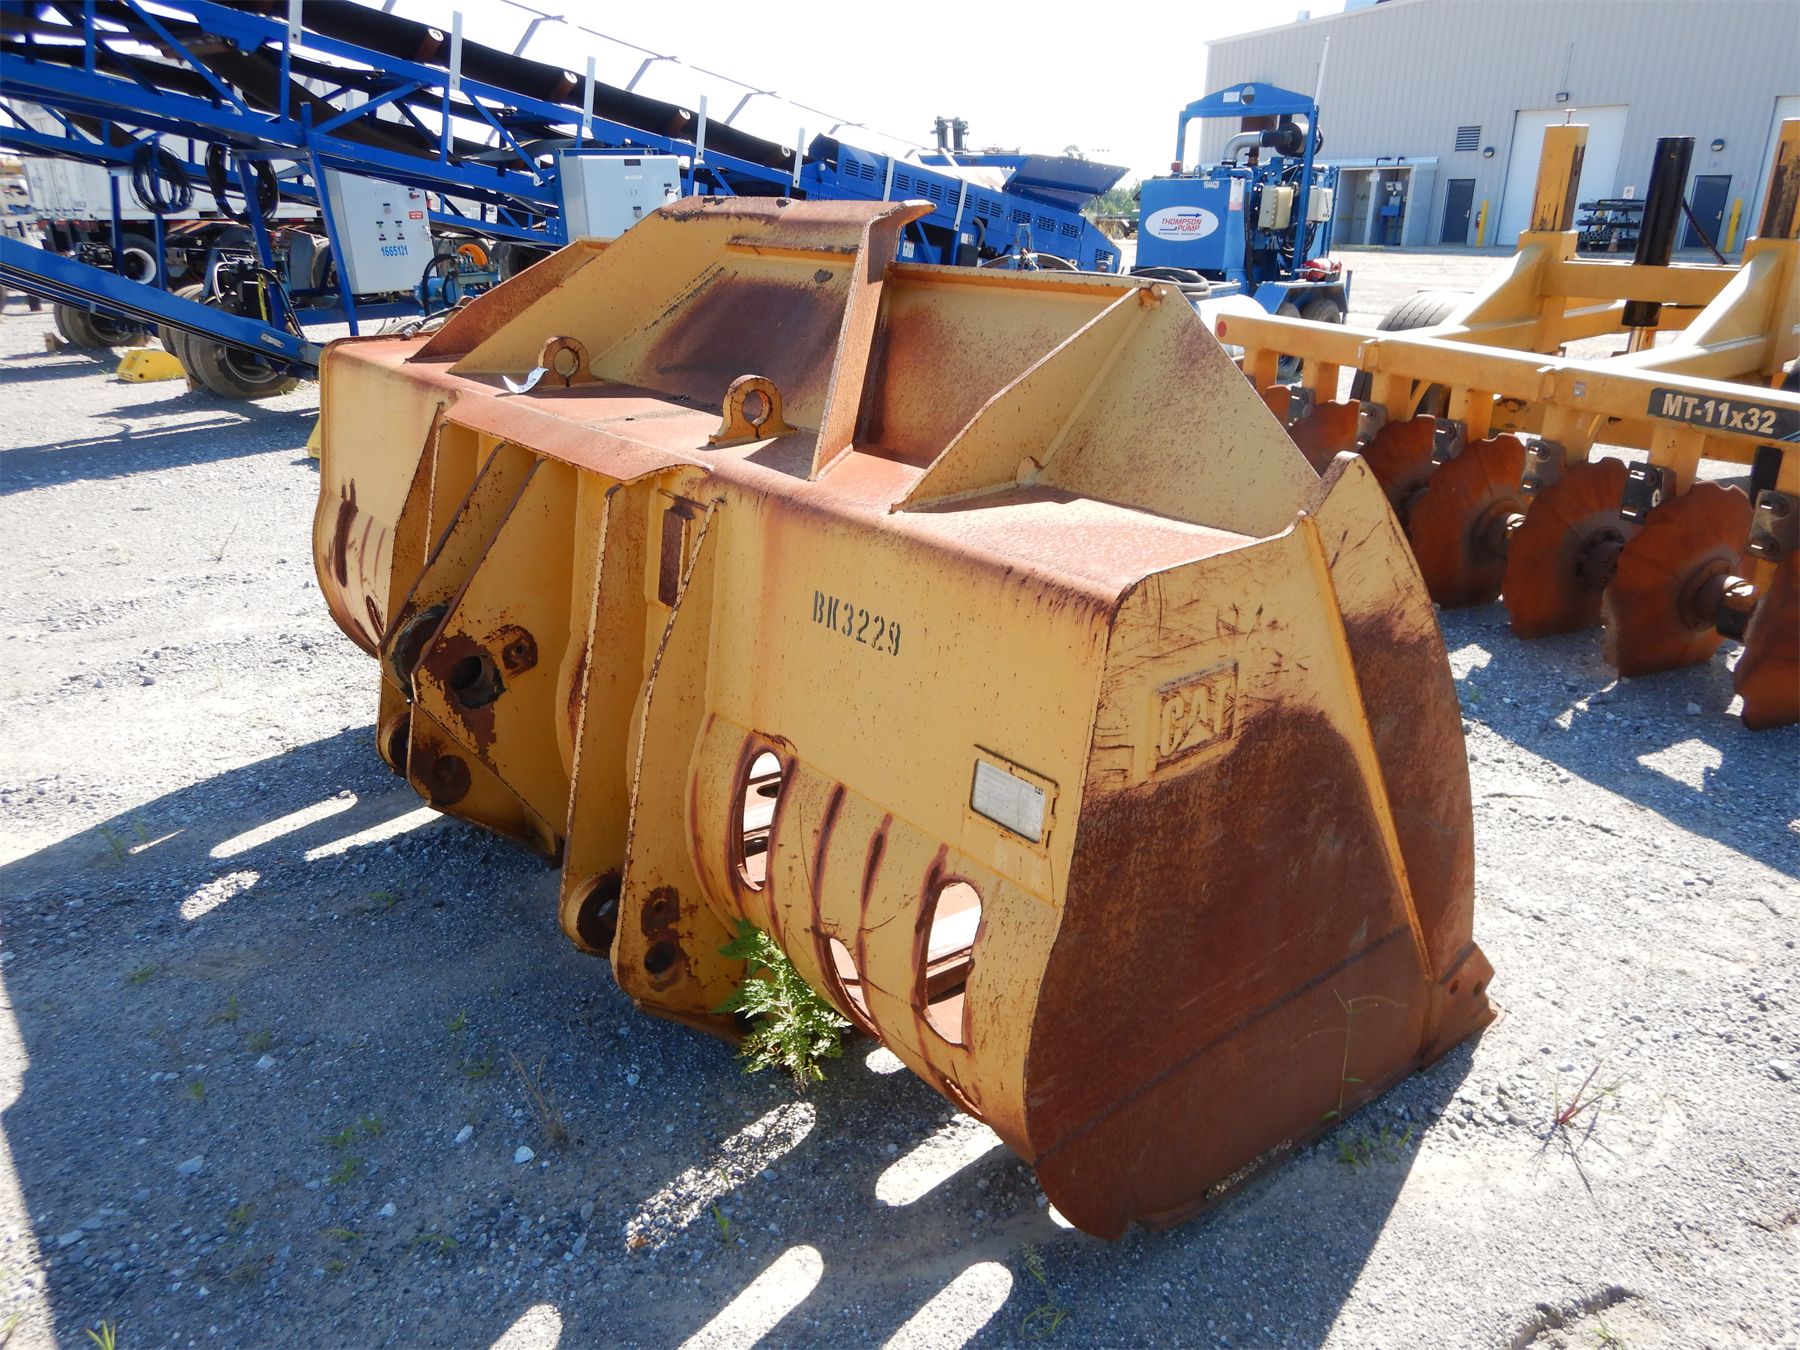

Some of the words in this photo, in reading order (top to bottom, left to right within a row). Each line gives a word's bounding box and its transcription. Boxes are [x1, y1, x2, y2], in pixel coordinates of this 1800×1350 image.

[381, 245, 408, 257] 1665121
[1662, 393, 1777, 434] MT-11x32
[812, 590, 901, 657] BK3229
[1160, 679, 1232, 757] CAT
